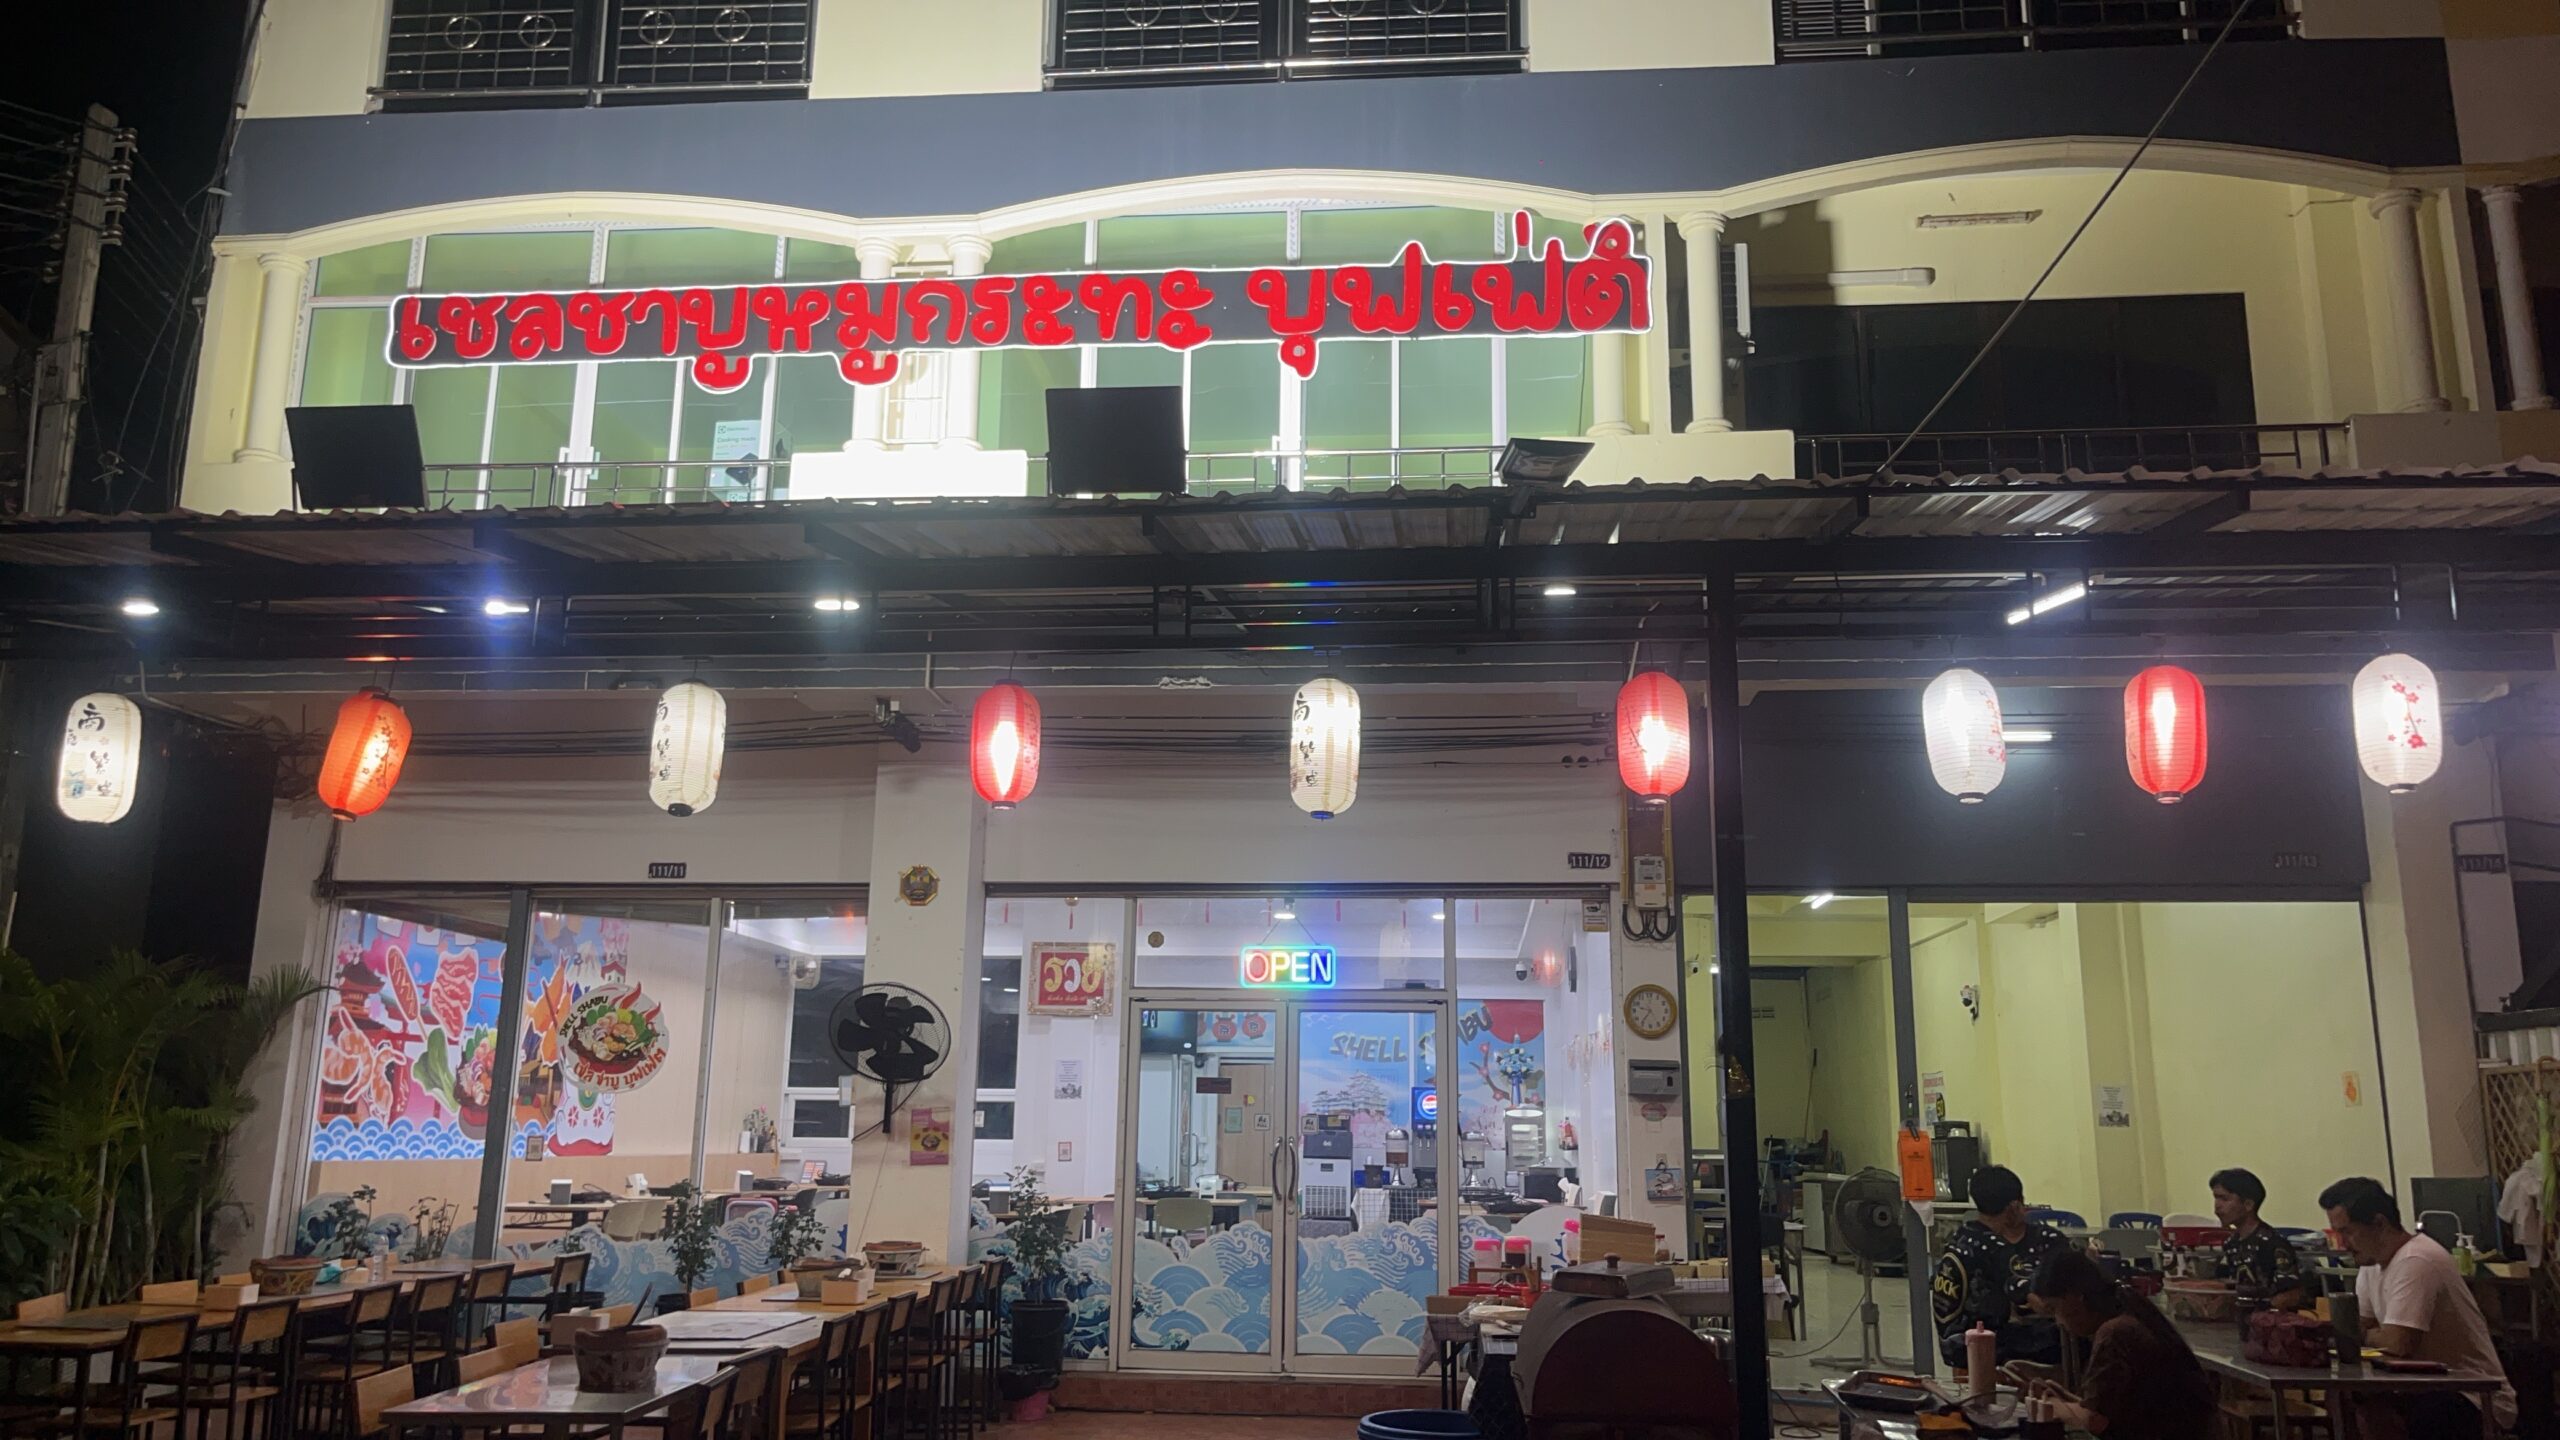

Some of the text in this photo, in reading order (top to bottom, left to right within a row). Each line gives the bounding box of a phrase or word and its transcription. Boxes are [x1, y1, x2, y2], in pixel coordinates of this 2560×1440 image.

[652, 864, 685, 877] 111/11
[1571, 854, 1608, 868] 111/12
[1043, 956, 1104, 994] รวย
[1245, 950, 1332, 983] OPEN
[559, 995, 609, 1038] SHELL SHABU
[1329, 1031, 1408, 1064] SHELL
